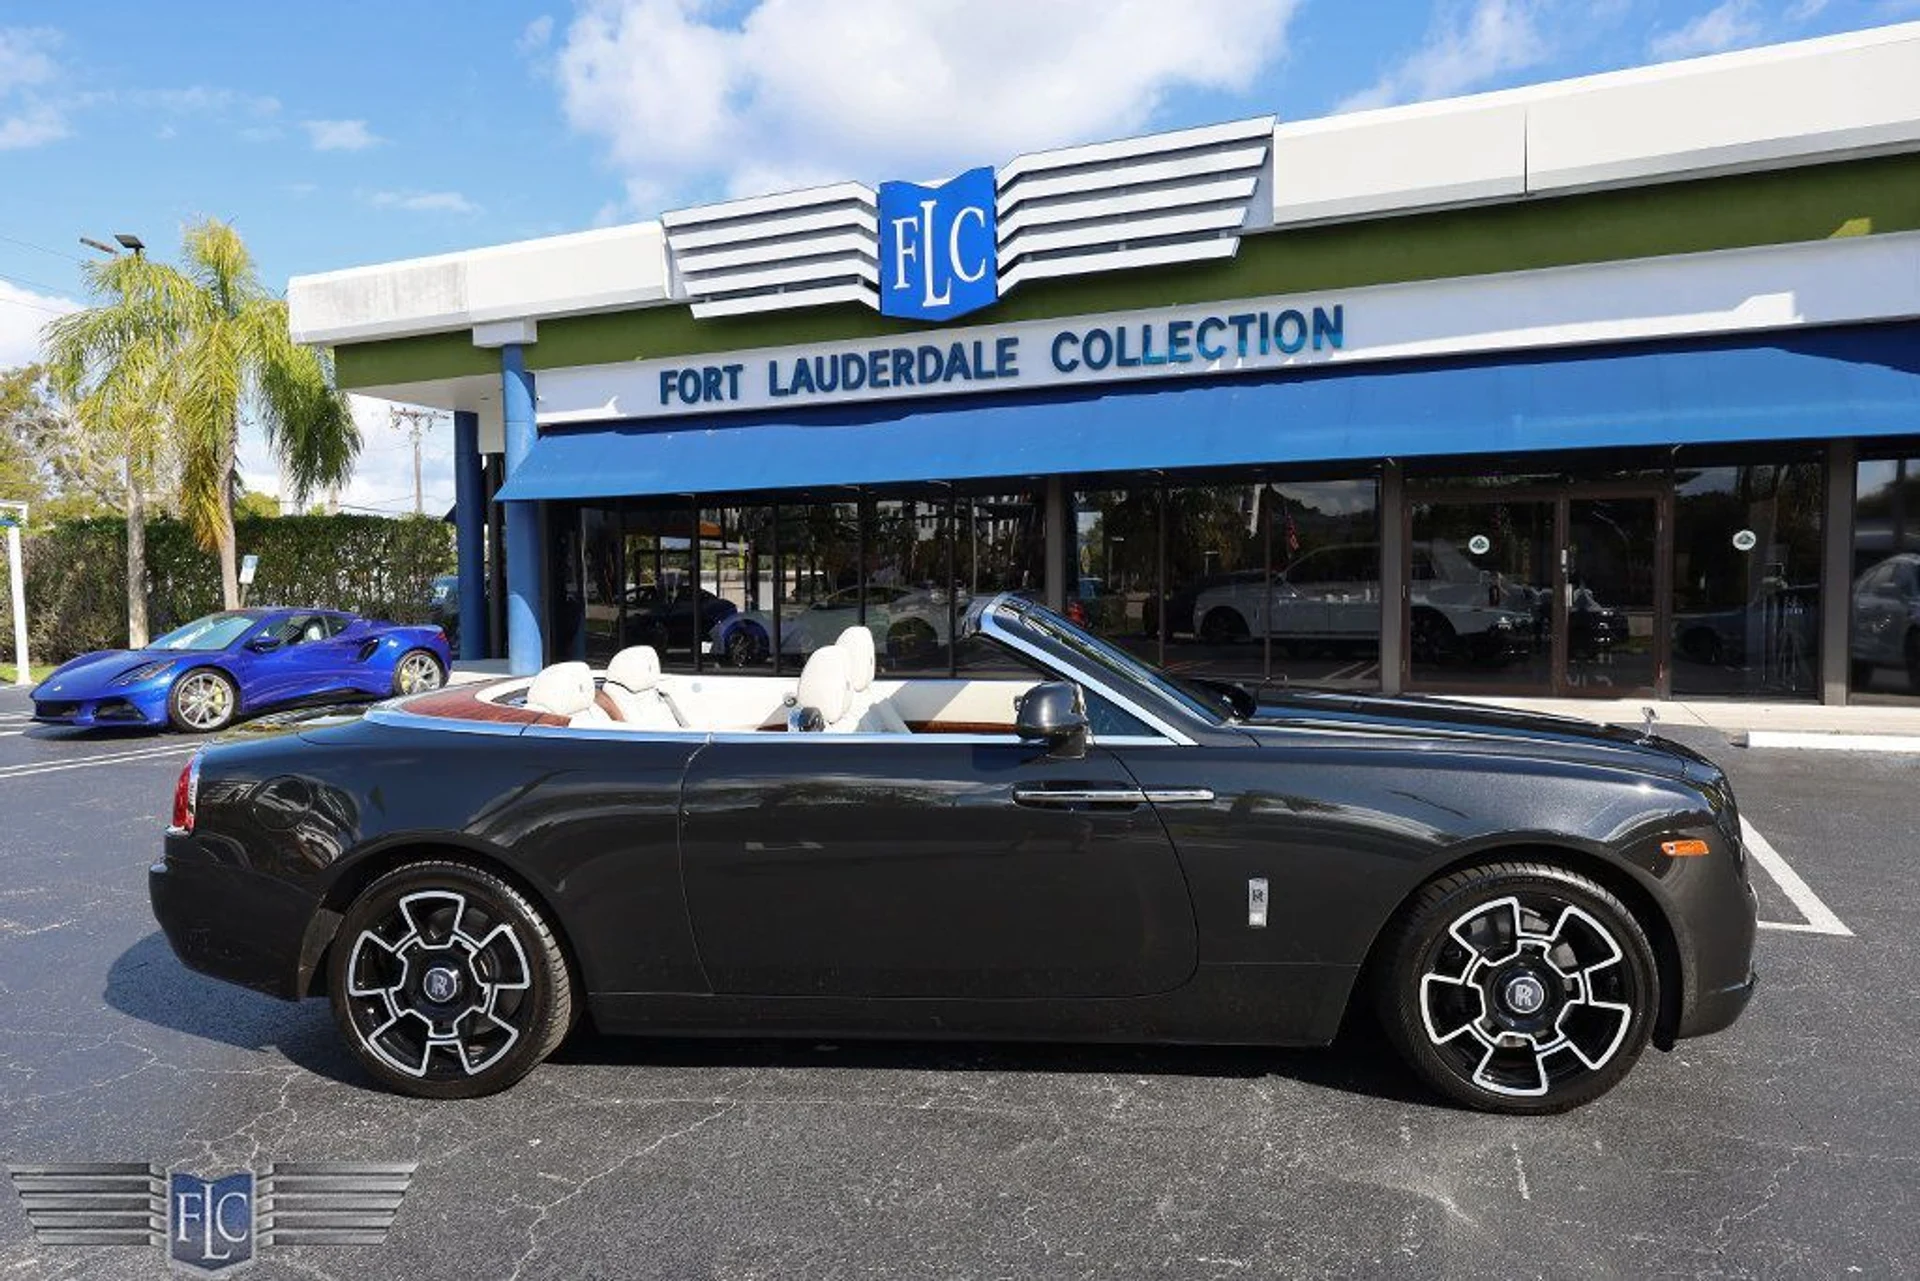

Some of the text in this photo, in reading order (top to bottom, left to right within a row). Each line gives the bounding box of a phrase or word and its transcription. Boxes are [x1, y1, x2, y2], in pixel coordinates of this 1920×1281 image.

[892, 199, 986, 307] FLC
[659, 304, 1344, 405] FORT LAUDERDALE COLLECTION
